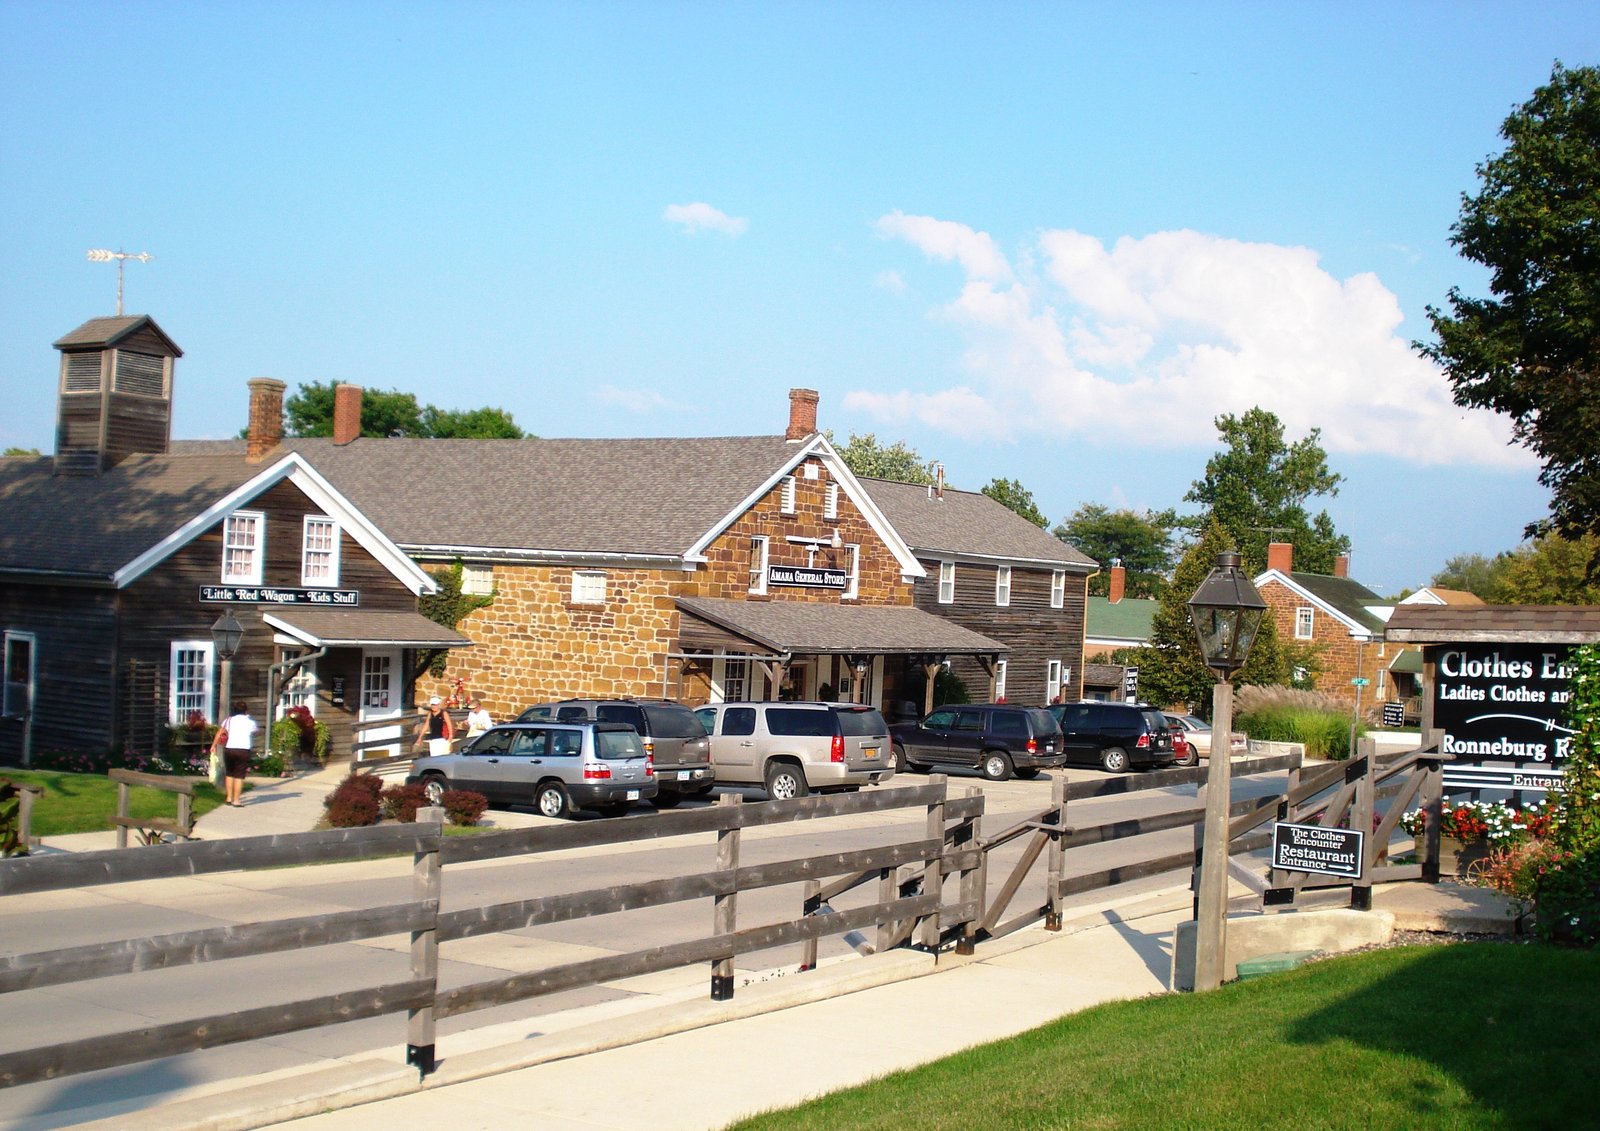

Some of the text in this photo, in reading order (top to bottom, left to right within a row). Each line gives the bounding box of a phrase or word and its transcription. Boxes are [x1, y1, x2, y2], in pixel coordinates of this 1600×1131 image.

[770, 569, 845, 585] AMANA GENERAL STORE
[203, 588, 233, 600] Little
[235, 589, 257, 600] Red
[260, 590, 294, 603] Wagon
[307, 591, 331, 602] Kids
[333, 592, 355, 603] Stuff
[1441, 651, 1533, 678] Clothes
[1440, 683, 1485, 701] Ladies
[1490, 685, 1545, 702] Clothes
[1443, 734, 1547, 761] Ronneburg
[1290, 828, 1346, 842] The Clothes
[1293, 836, 1343, 849] Encounter
[1279, 844, 1355, 864] Restaurant
[1279, 855, 1327, 869] Entrance
